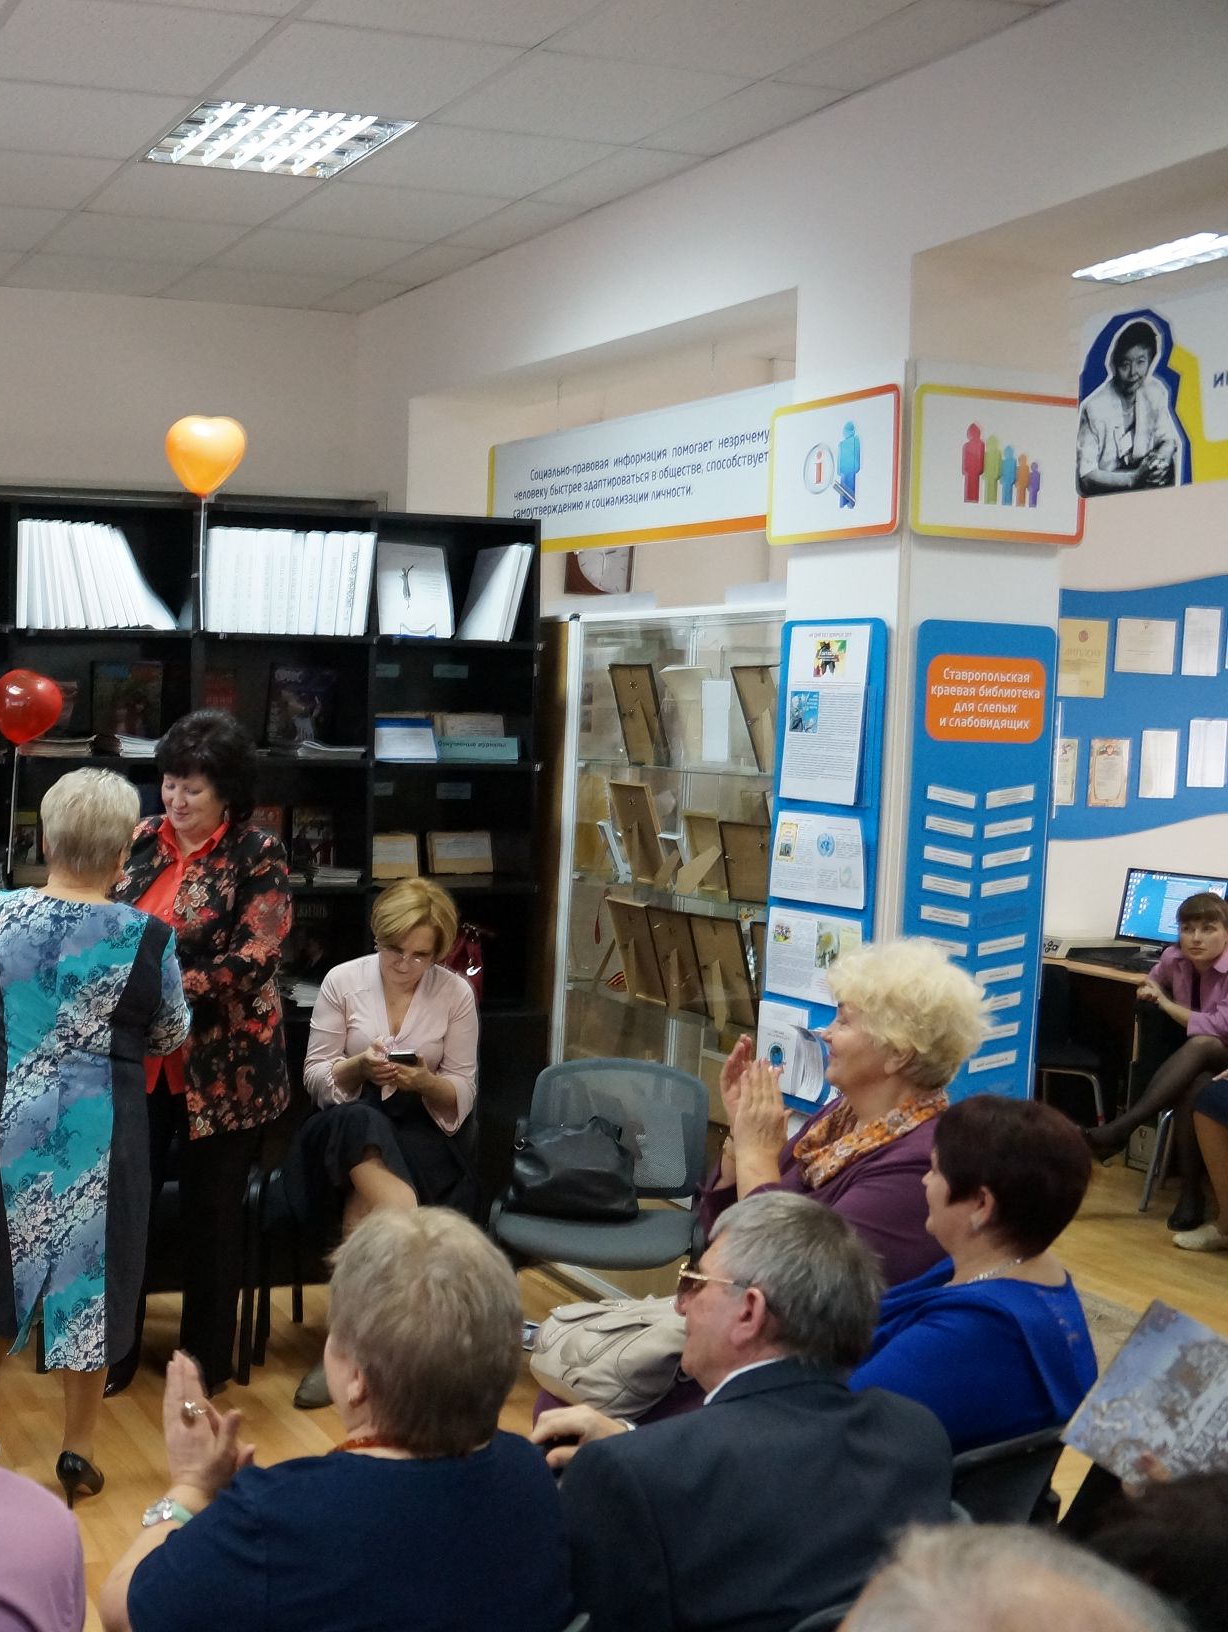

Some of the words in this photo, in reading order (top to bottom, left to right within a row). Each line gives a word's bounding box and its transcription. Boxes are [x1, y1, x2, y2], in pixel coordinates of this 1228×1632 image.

[530, 460, 609, 481] Социально-правовая
[613, 449, 667, 471] информация
[672, 440, 713, 457] помогает
[718, 429, 770, 449] незрячему
[514, 485, 548, 502] человеку
[550, 482, 582, 499] быстрее
[583, 471, 649, 493] адаптироваться
[659, 461, 704, 480] обществе,
[706, 451, 769, 472] способствует
[513, 500, 583, 519] самоутверждению
[592, 491, 649, 509] социализации
[651, 484, 694, 500] личности.
[943, 668, 1030, 683] Ставропольская
[931, 685, 976, 698] краевая
[979, 684, 1040, 699] библиотека
[953, 702, 974, 714] для
[977, 702, 1017, 713] слепых
[939, 717, 947, 727] и
[949, 715, 1030, 730] слабовидящих
